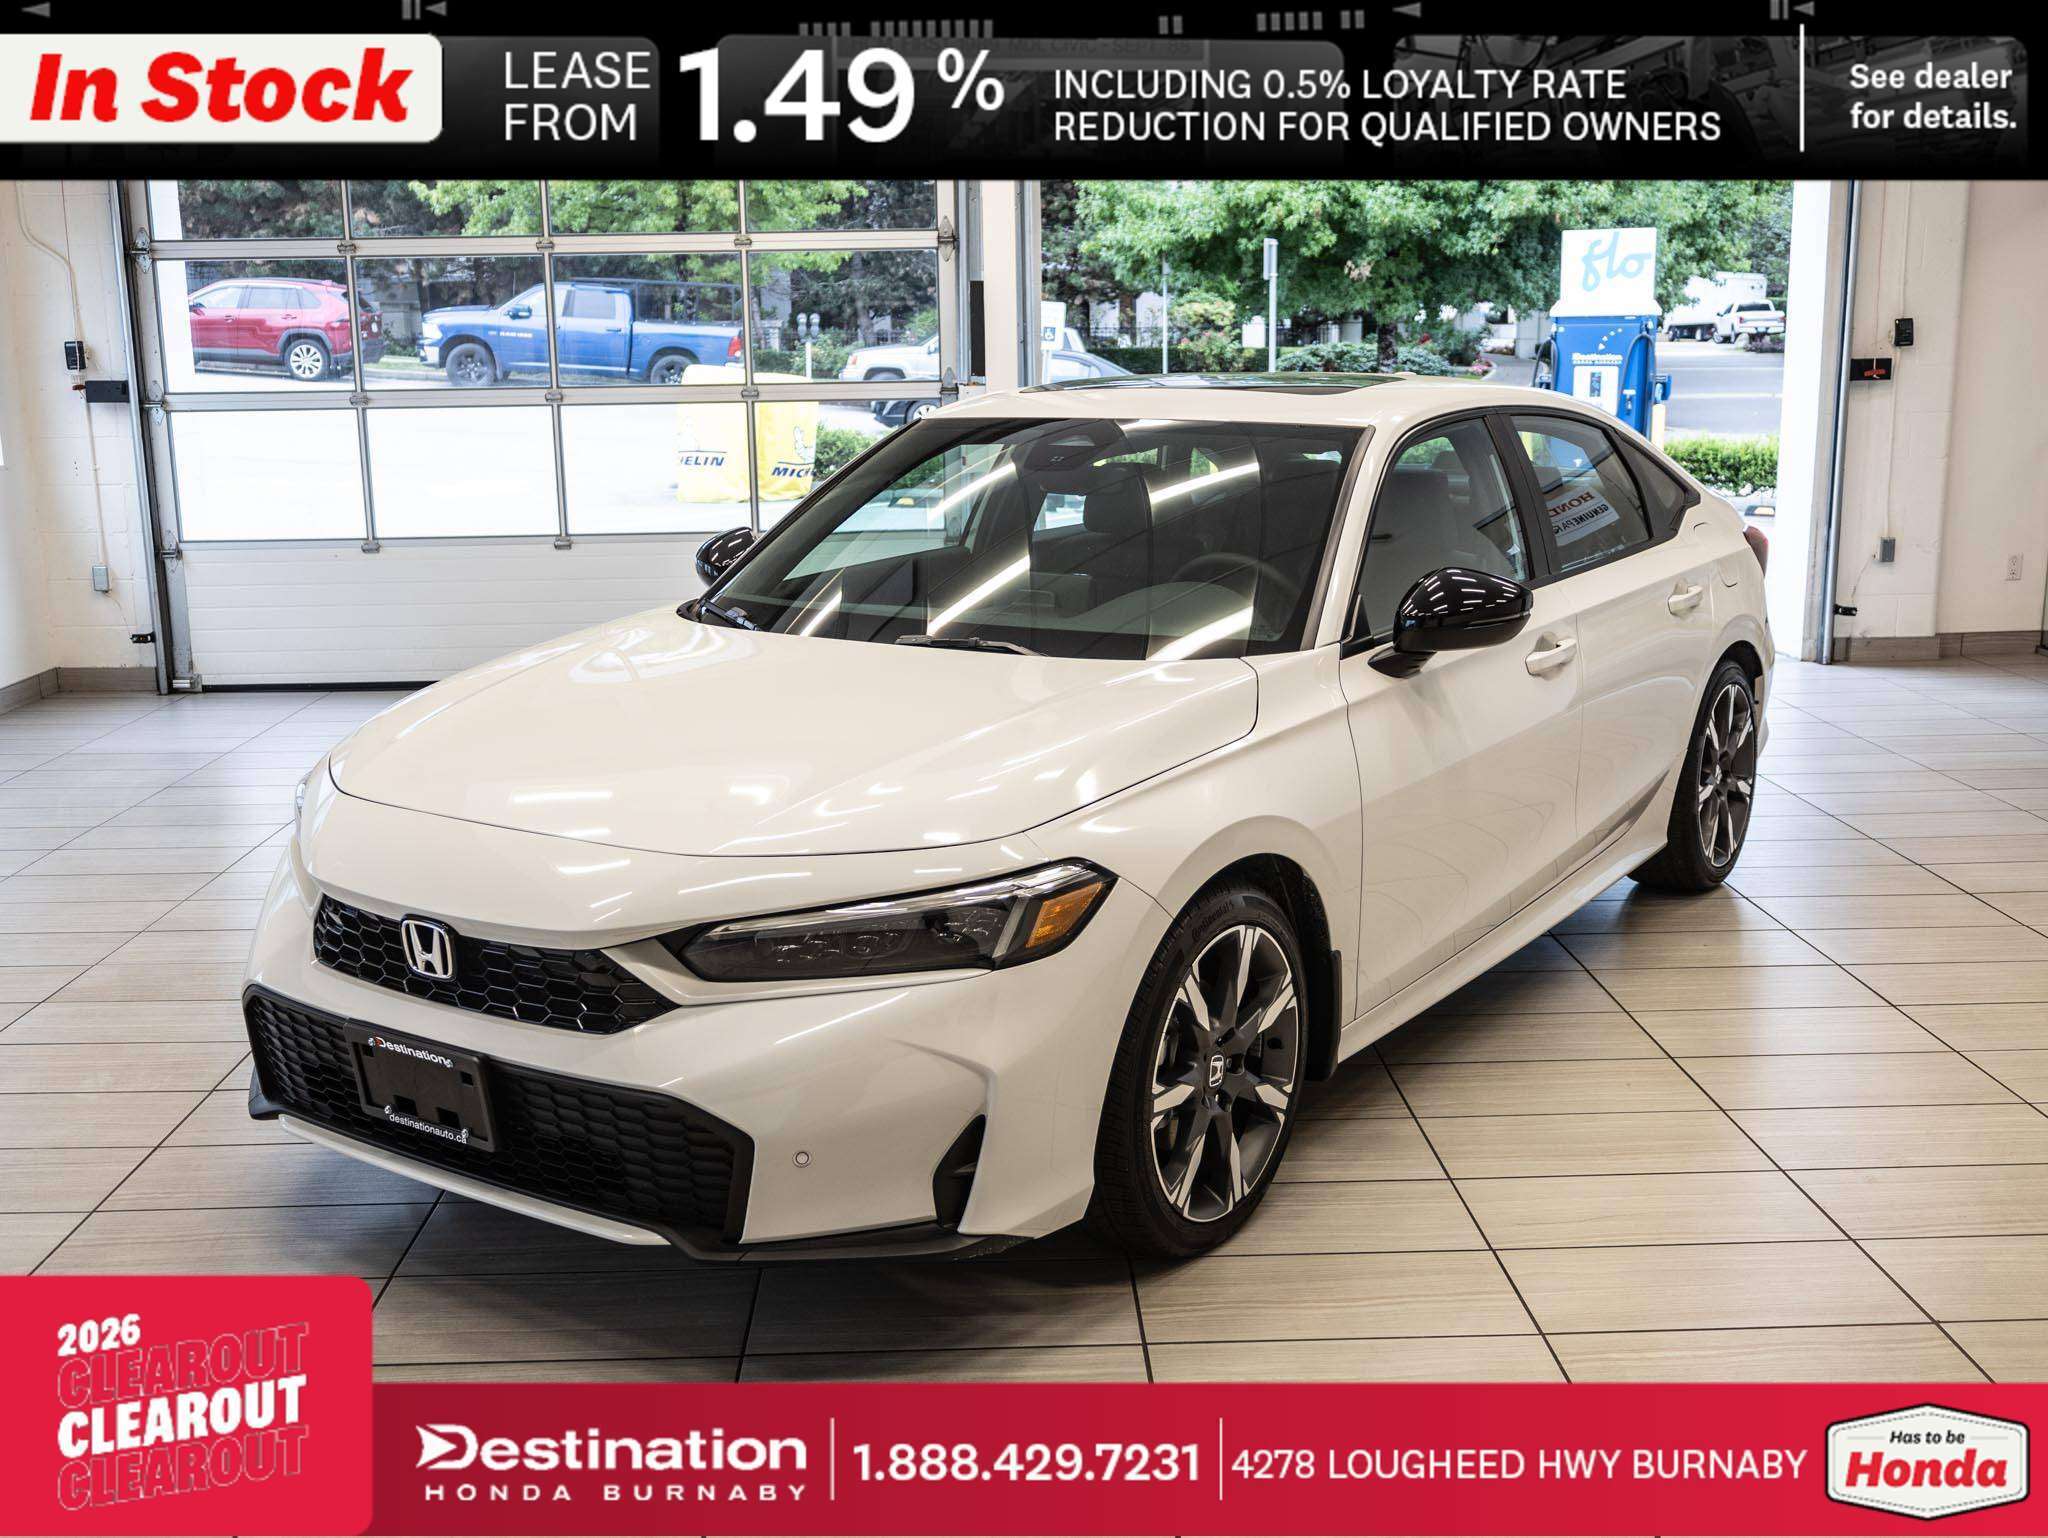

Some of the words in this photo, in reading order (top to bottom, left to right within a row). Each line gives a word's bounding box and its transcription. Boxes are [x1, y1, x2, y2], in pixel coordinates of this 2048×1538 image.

[1582, 231, 1651, 292] flo
[373, 1035, 449, 1067] Destination
[389, 1113, 467, 1145] destinationauto.ca
